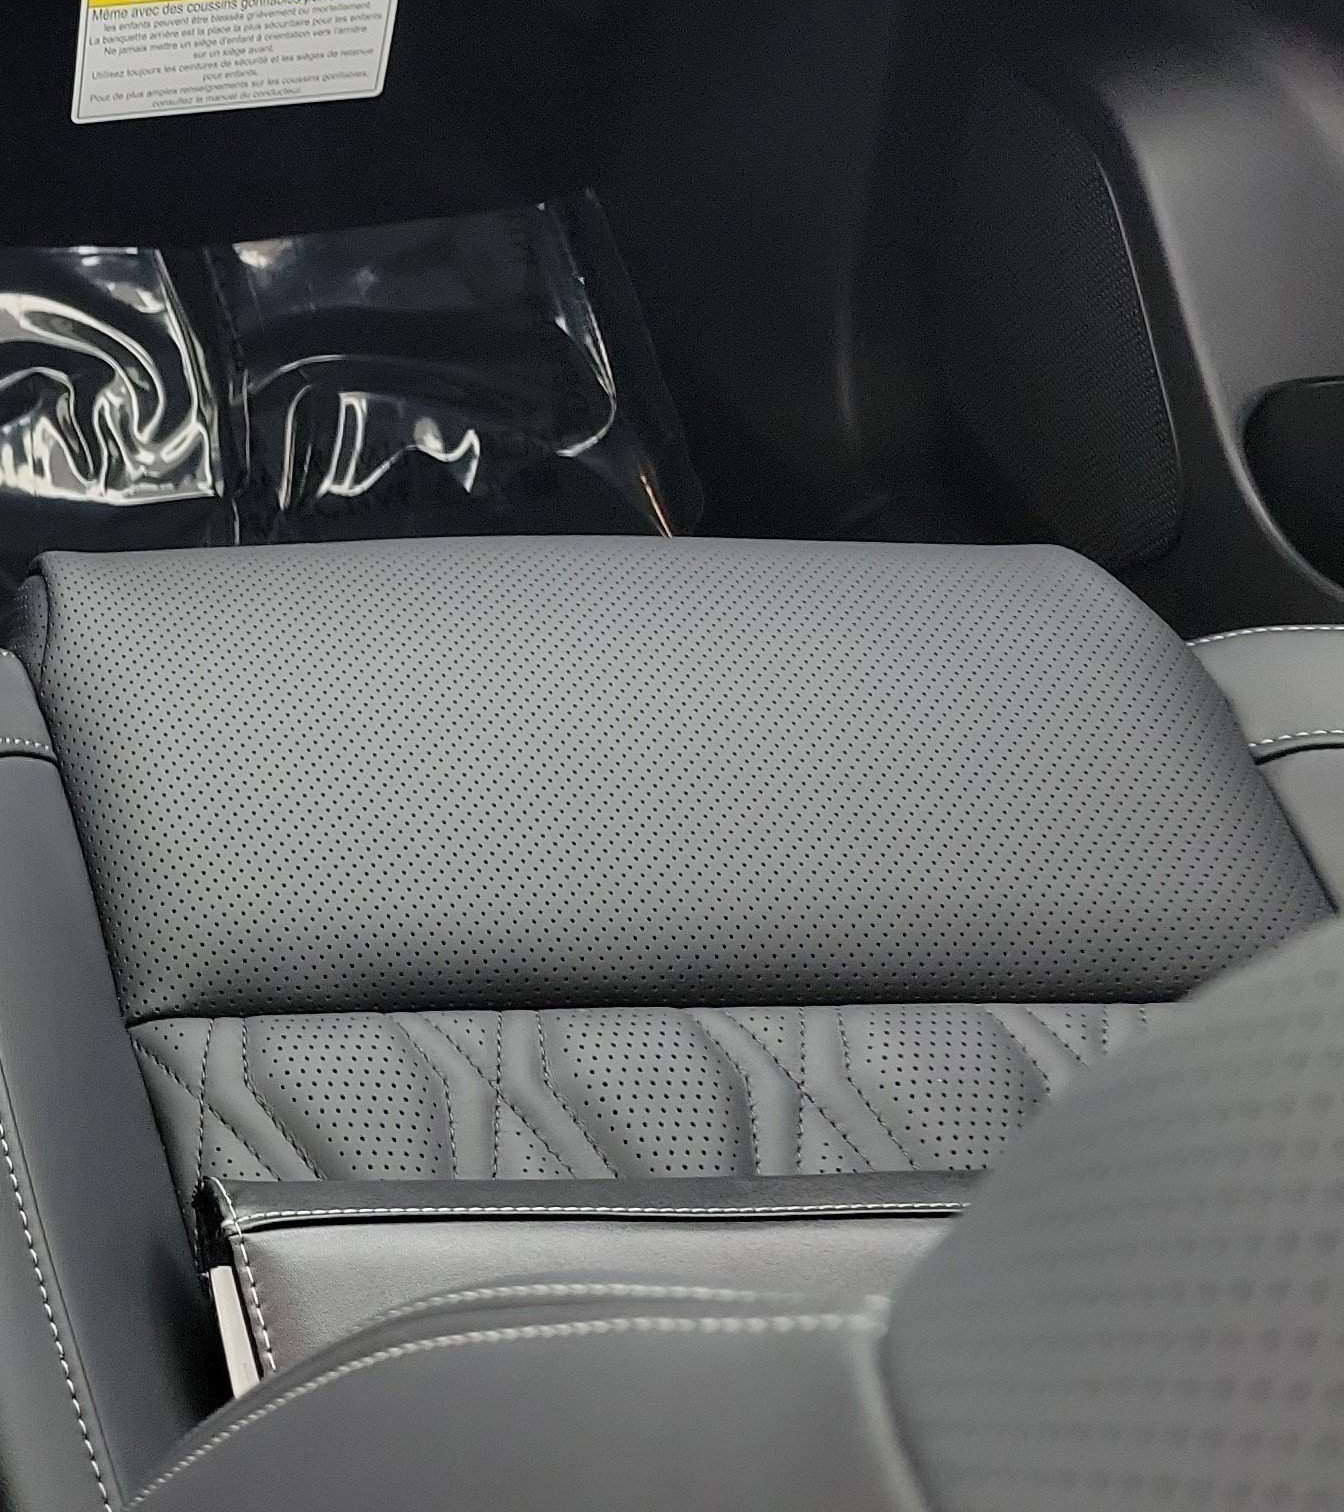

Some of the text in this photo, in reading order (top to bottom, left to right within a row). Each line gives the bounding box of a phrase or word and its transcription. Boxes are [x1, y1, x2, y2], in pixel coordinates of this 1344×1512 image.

[91, 5, 128, 21] Même
[131, 6, 159, 18] avec
[162, 1, 183, 16] des
